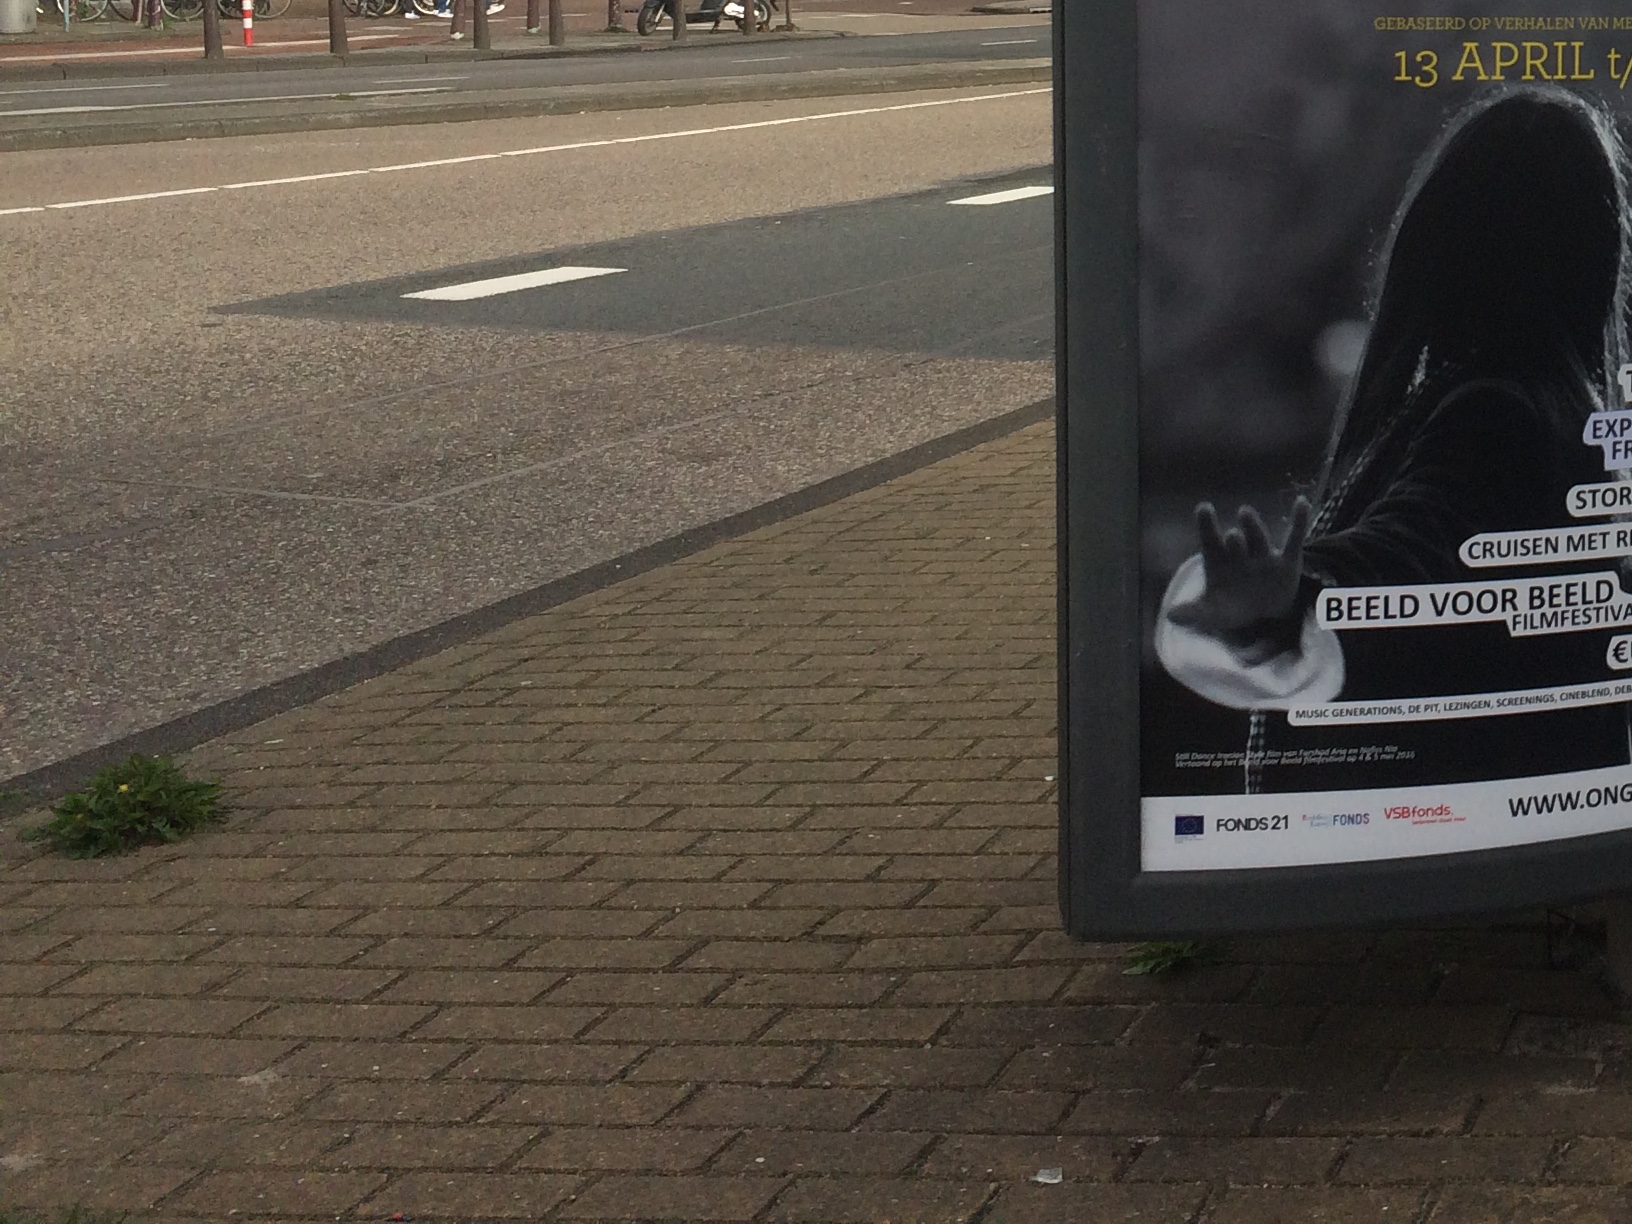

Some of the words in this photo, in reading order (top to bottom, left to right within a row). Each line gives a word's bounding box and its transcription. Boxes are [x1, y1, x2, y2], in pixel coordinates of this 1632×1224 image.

[1373, 16, 1466, 31] GEBASEERD
[1469, 16, 1491, 31] OP
[1494, 16, 1576, 31] VERHALEN
[1578, 16, 1609, 30] VAN
[1394, 50, 1438, 88] 13
[1452, 41, 1595, 82] APRIL
[1466, 535, 1560, 562] CRUISEN
[1565, 530, 1612, 555] MET
[1325, 593, 1420, 622] BEELD
[1430, 587, 1520, 616] VOOR
[1528, 578, 1615, 612] BEELD
[1295, 708, 1330, 719] MUSIC
[1331, 704, 1406, 718] GENERATIONS,
[1408, 704, 1422, 714] DE
[1423, 702, 1441, 714] PIT,
[1443, 698, 1495, 713] LEZINGEN,
[1496, 693, 1558, 708] SCREENINGS,
[1559, 687, 1613, 702] CINEBLEND,
[1216, 817, 1269, 833] FONDS
[1271, 814, 1290, 832] 21
[1332, 813, 1370, 826] FONDS
